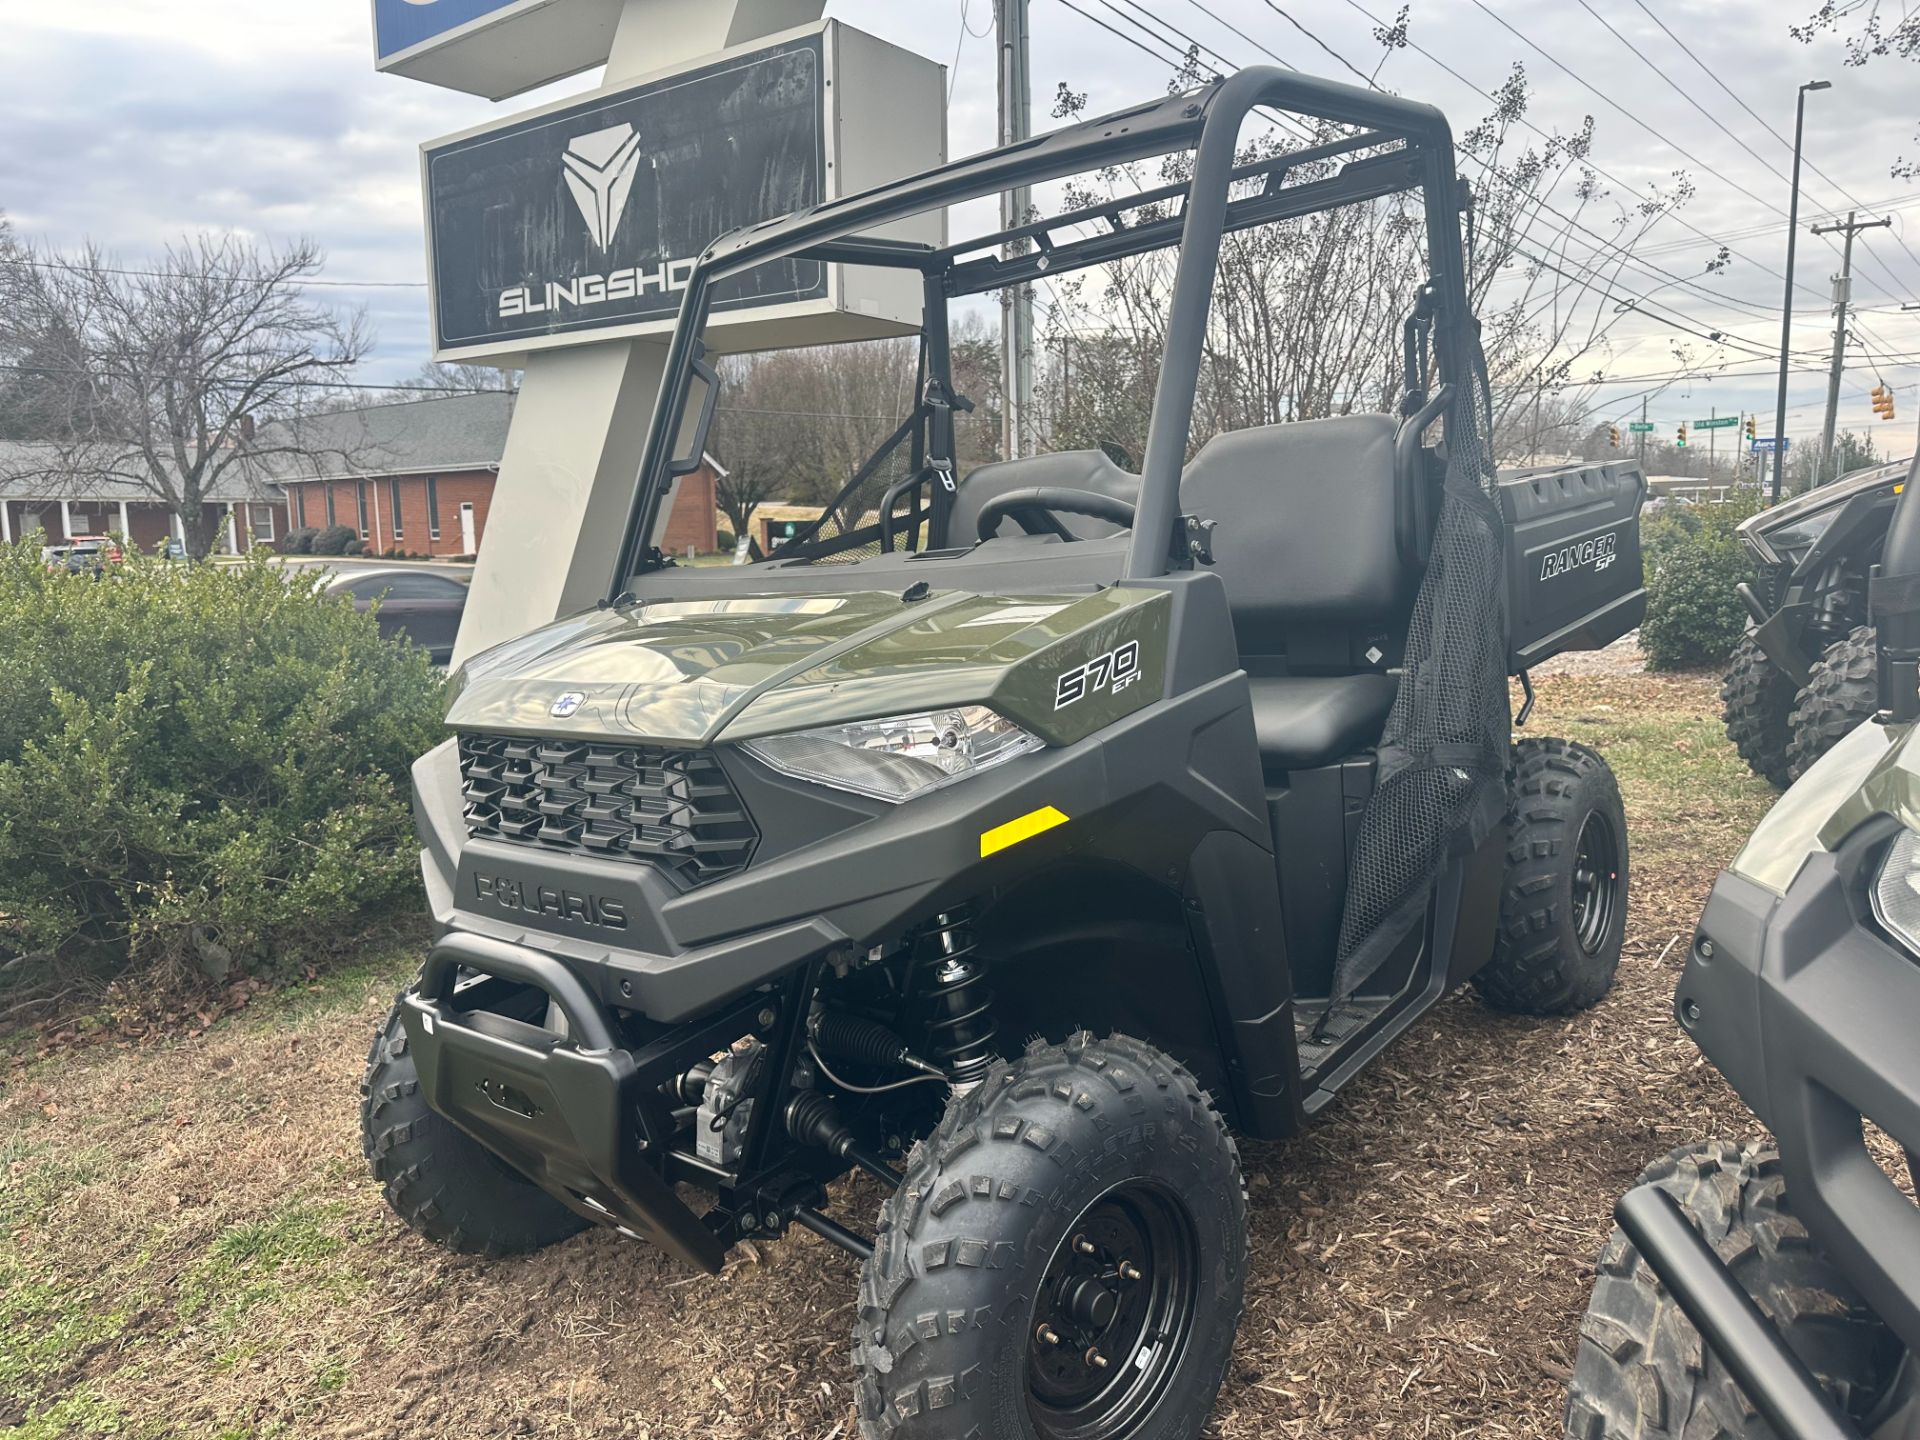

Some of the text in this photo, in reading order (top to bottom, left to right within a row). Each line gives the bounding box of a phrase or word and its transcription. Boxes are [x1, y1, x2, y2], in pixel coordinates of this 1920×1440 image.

[499, 256, 700, 318] SLINGSHO
[1540, 532, 1616, 580] RANGER
[1594, 553, 1616, 572] SP
[1054, 640, 1139, 711] 570
[1111, 670, 1142, 695] EFI
[474, 871, 628, 931] POLARIS
